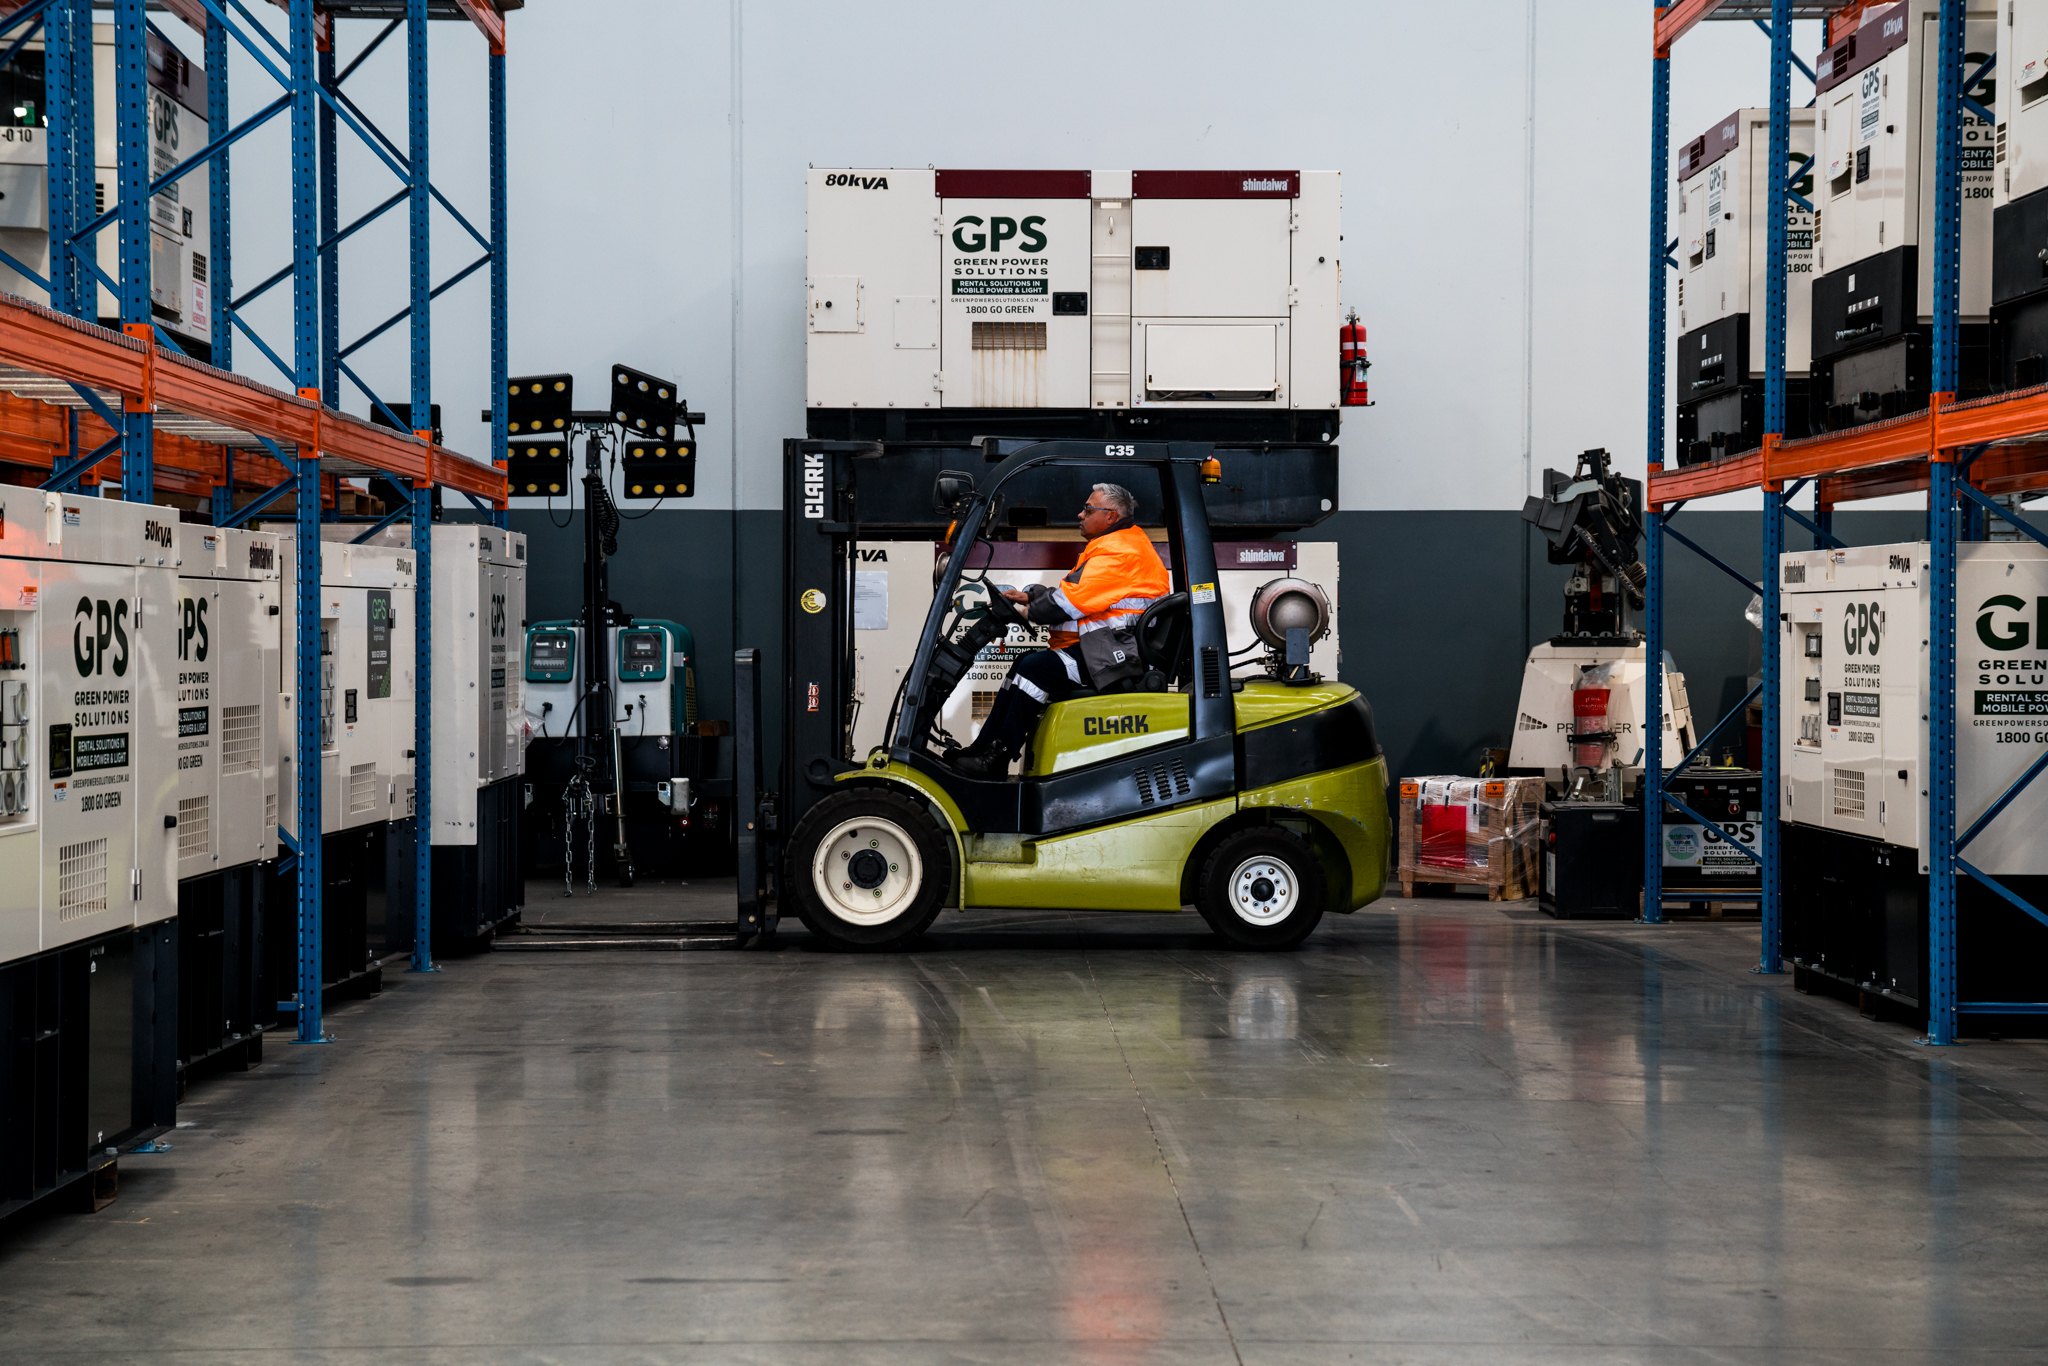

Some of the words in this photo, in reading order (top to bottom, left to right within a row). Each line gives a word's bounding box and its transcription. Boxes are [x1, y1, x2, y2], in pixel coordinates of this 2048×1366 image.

[1862, 66, 1880, 99] GPS
[154, 93, 179, 151] GPS
[825, 174, 889, 190] 80kVA
[1242, 178, 1288, 191] shindaiwa
[952, 215, 1048, 253] GPS
[954, 258, 998, 266] GREEN
[1001, 258, 1049, 266] POWER
[954, 267, 1048, 276] SOLUTIONS
[966, 306, 988, 314] 1800
[990, 306, 1003, 314] GO
[1004, 306, 1034, 314] GREEN
[1105, 444, 1135, 456] C35
[804, 453, 824, 519] CLARK
[145, 519, 172, 548] 50kVA
[1240, 549, 1286, 562] shindaiwa
[1889, 554, 1911, 574] 50kVA
[372, 598, 387, 620] GPS
[491, 593, 506, 639] GPS
[74, 596, 129, 678] GPS
[178, 597, 208, 662] PS
[1844, 602, 1880, 656] GPS
[1844, 663, 1861, 674] GREEN
[1862, 664, 1880, 675] POWER
[1978, 660, 2047, 670] GREEN
[188, 672, 209, 684] POWER
[966, 672, 988, 681] 1800
[990, 672, 1003, 681] GO
[1844, 677, 1880, 688] SOLUTIONS
[74, 691, 102, 706] GREEN
[102, 690, 130, 705] POWER
[1986, 694, 2032, 702] RENTAL
[1982, 704, 2026, 712] MOBILE
[75, 710, 130, 728] SOLUTIONS
[1084, 714, 1149, 736] CLARK
[78, 740, 95, 752] RENTAL
[96, 738, 120, 751] SOLUTIONS
[120, 737, 126, 748] IN
[1848, 731, 1857, 742] 1800
[1863, 732, 1875, 744] GREEN
[1996, 732, 2030, 744] 1800
[76, 755, 94, 768] MOBILE
[94, 754, 110, 766] POWER
[114, 752, 126, 764] LIGHT
[190, 754, 204, 768] GREEN
[82, 796, 94, 812] 1800
[96, 793, 103, 809] GO
[104, 791, 122, 808] GREEN
[1703, 823, 1755, 844] GPS
